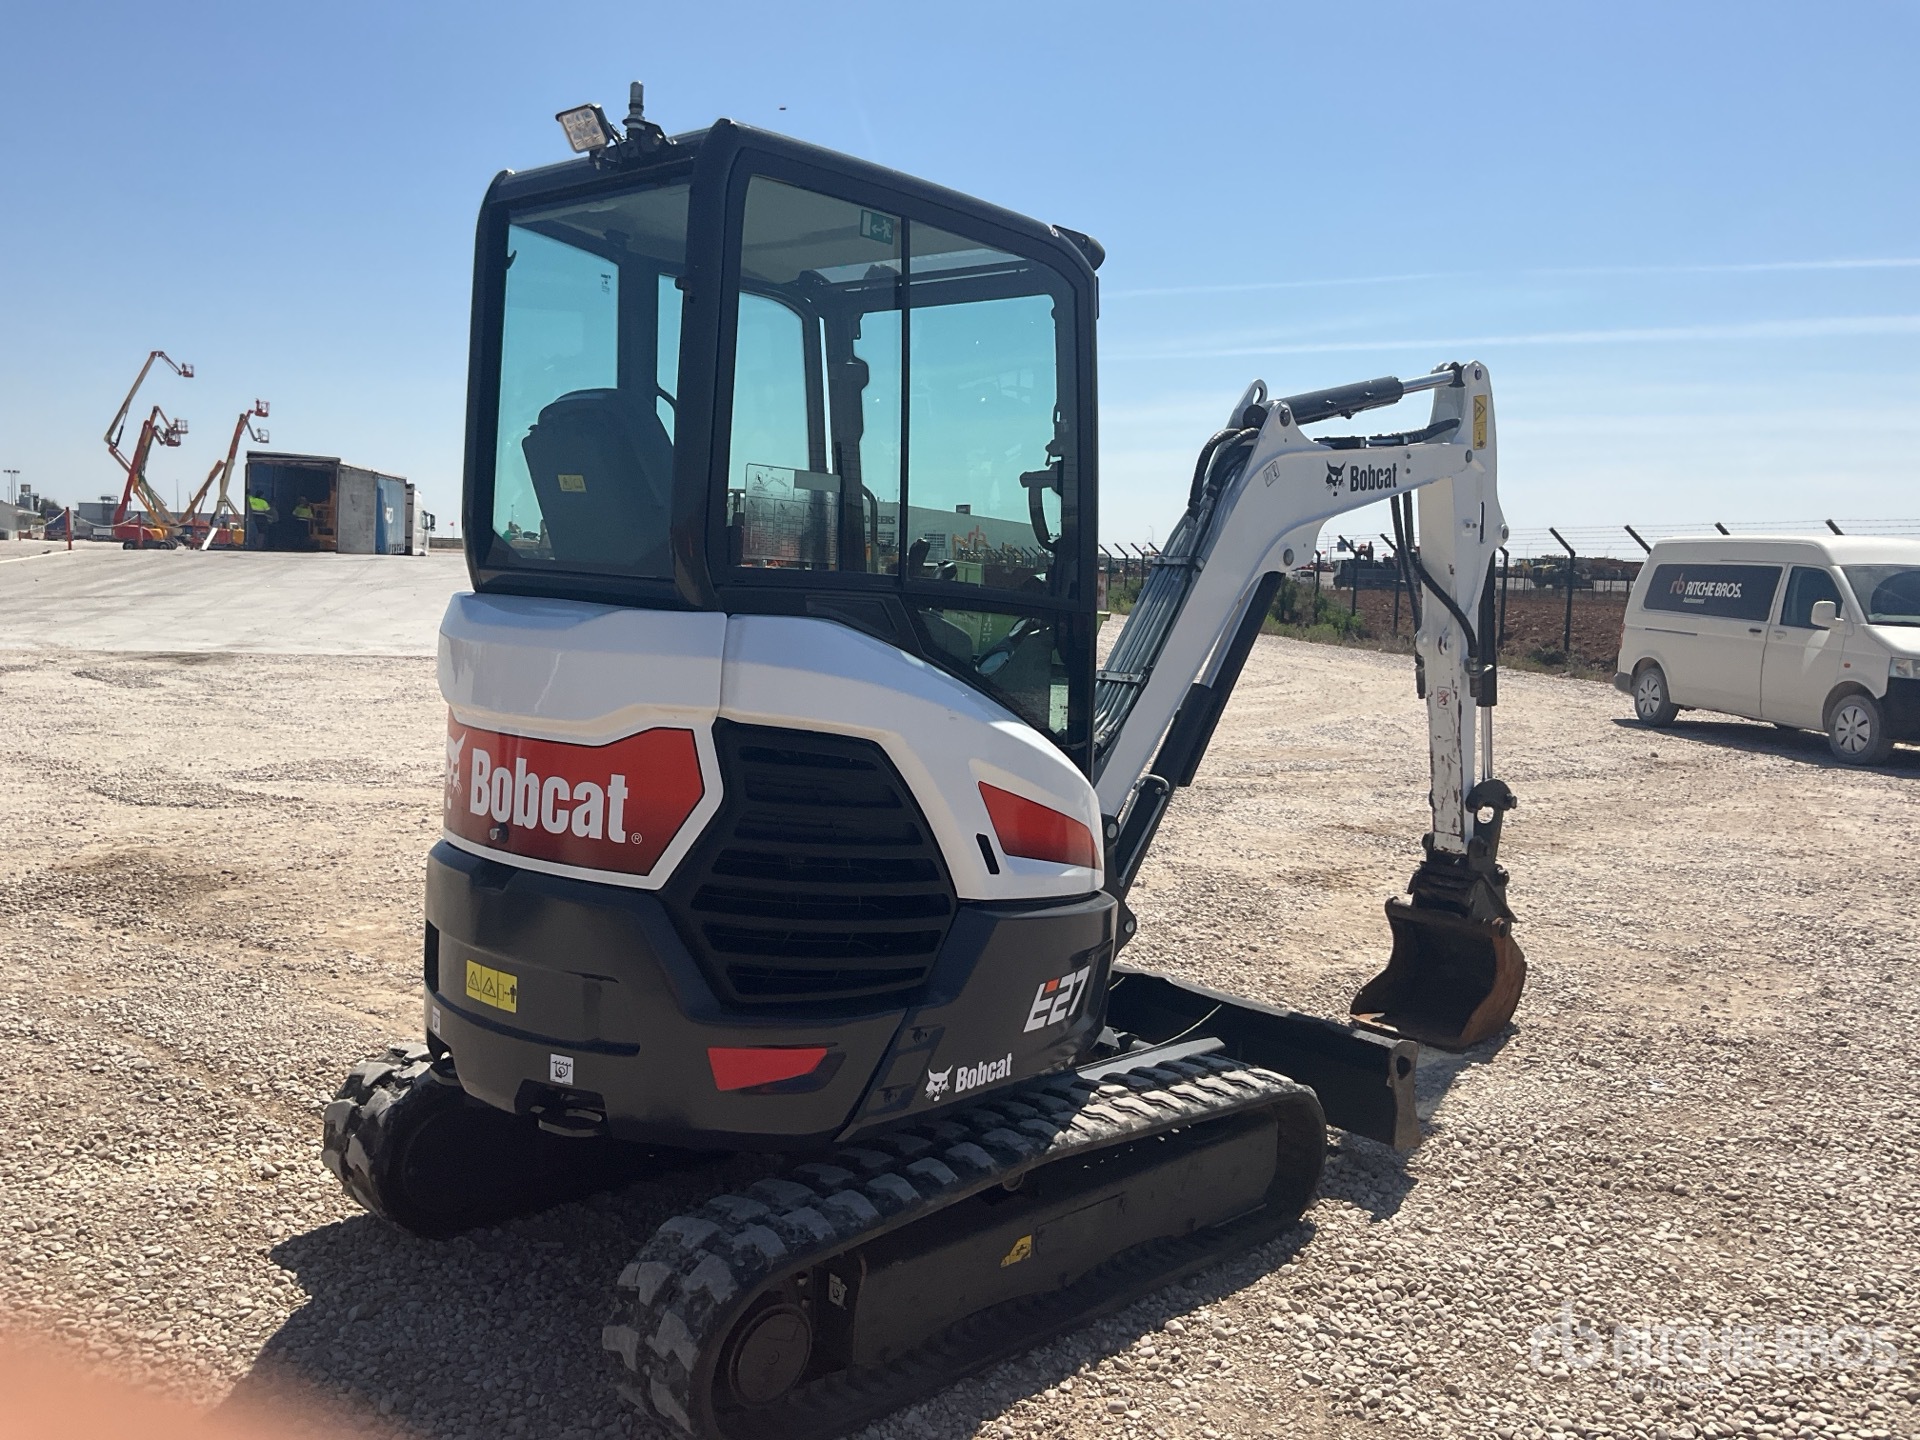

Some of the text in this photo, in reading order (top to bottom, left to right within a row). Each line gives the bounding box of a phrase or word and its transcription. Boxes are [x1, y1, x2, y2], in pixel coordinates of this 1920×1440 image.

[1350, 463, 1397, 492] Bobcat
[469, 748, 629, 844] Bobcat
[1023, 965, 1091, 1033] E27
[954, 1052, 1013, 1093] Bobcat
